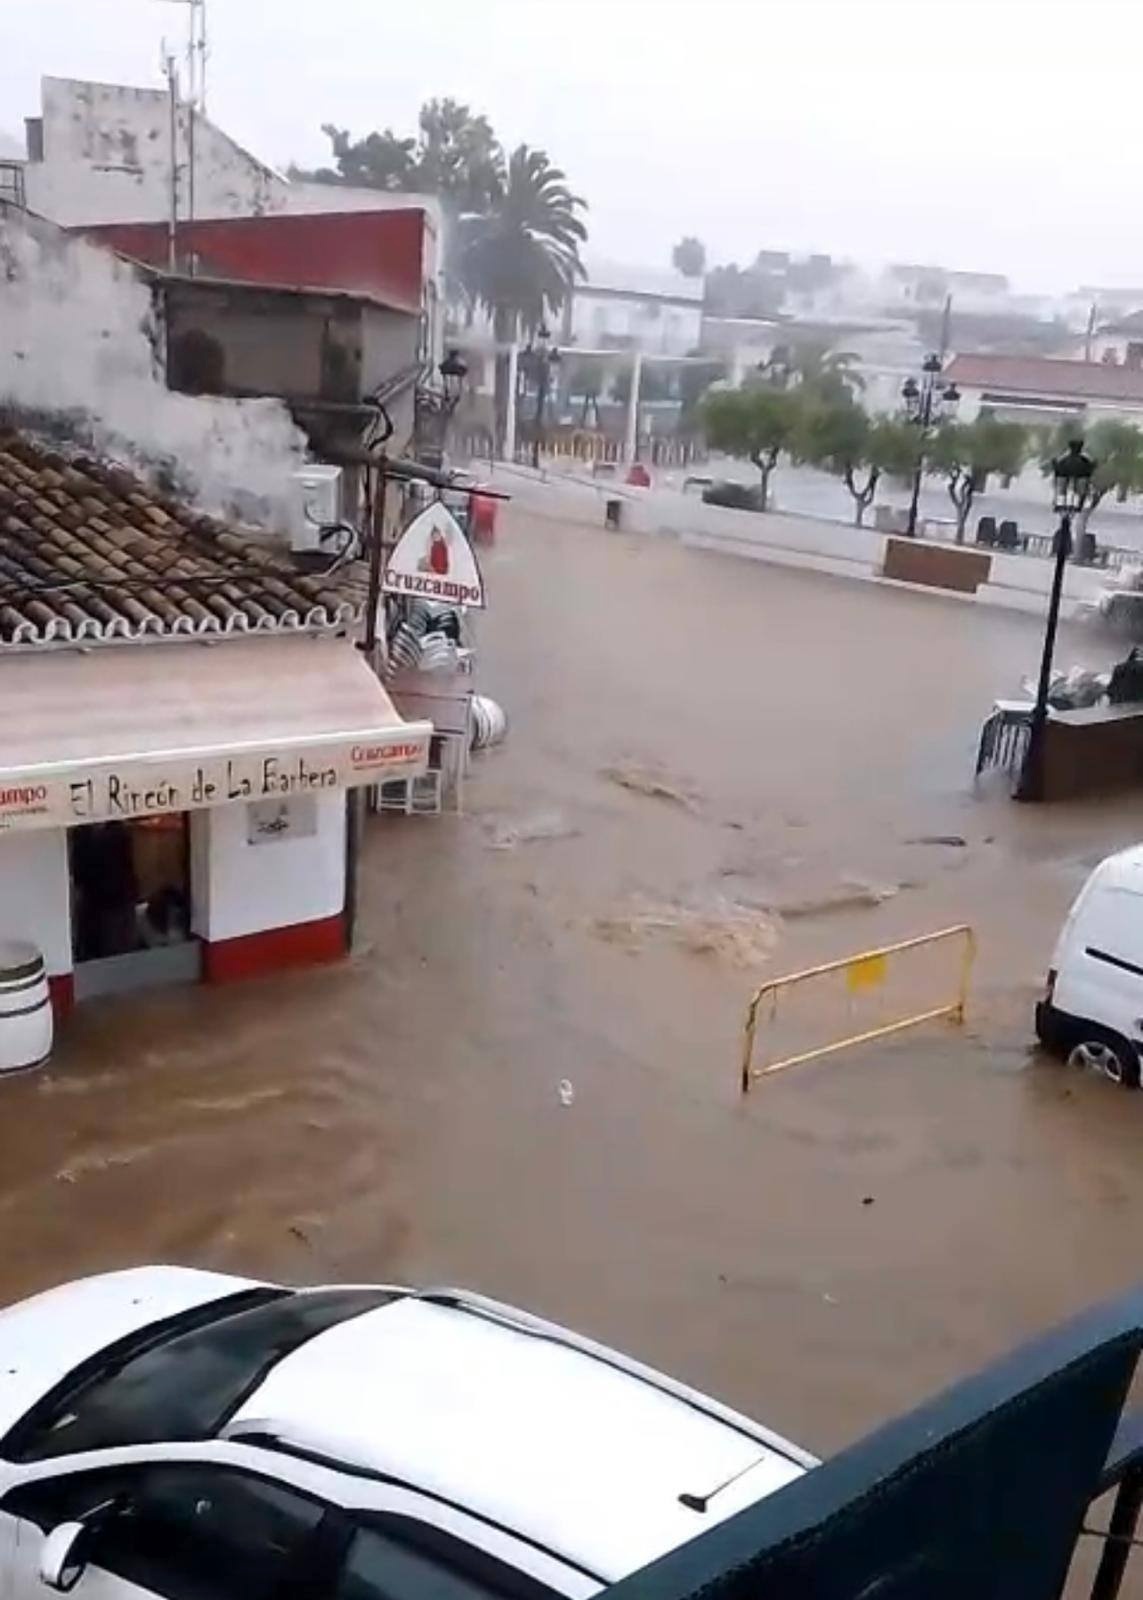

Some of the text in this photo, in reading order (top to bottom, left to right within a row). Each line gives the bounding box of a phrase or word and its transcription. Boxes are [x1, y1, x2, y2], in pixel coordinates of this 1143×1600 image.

[385, 568, 480, 605] Cruzcampo
[69, 779, 94, 816] El
[109, 775, 178, 814] Rincón
[192, 769, 215, 802] de
[228, 760, 251, 799] La
